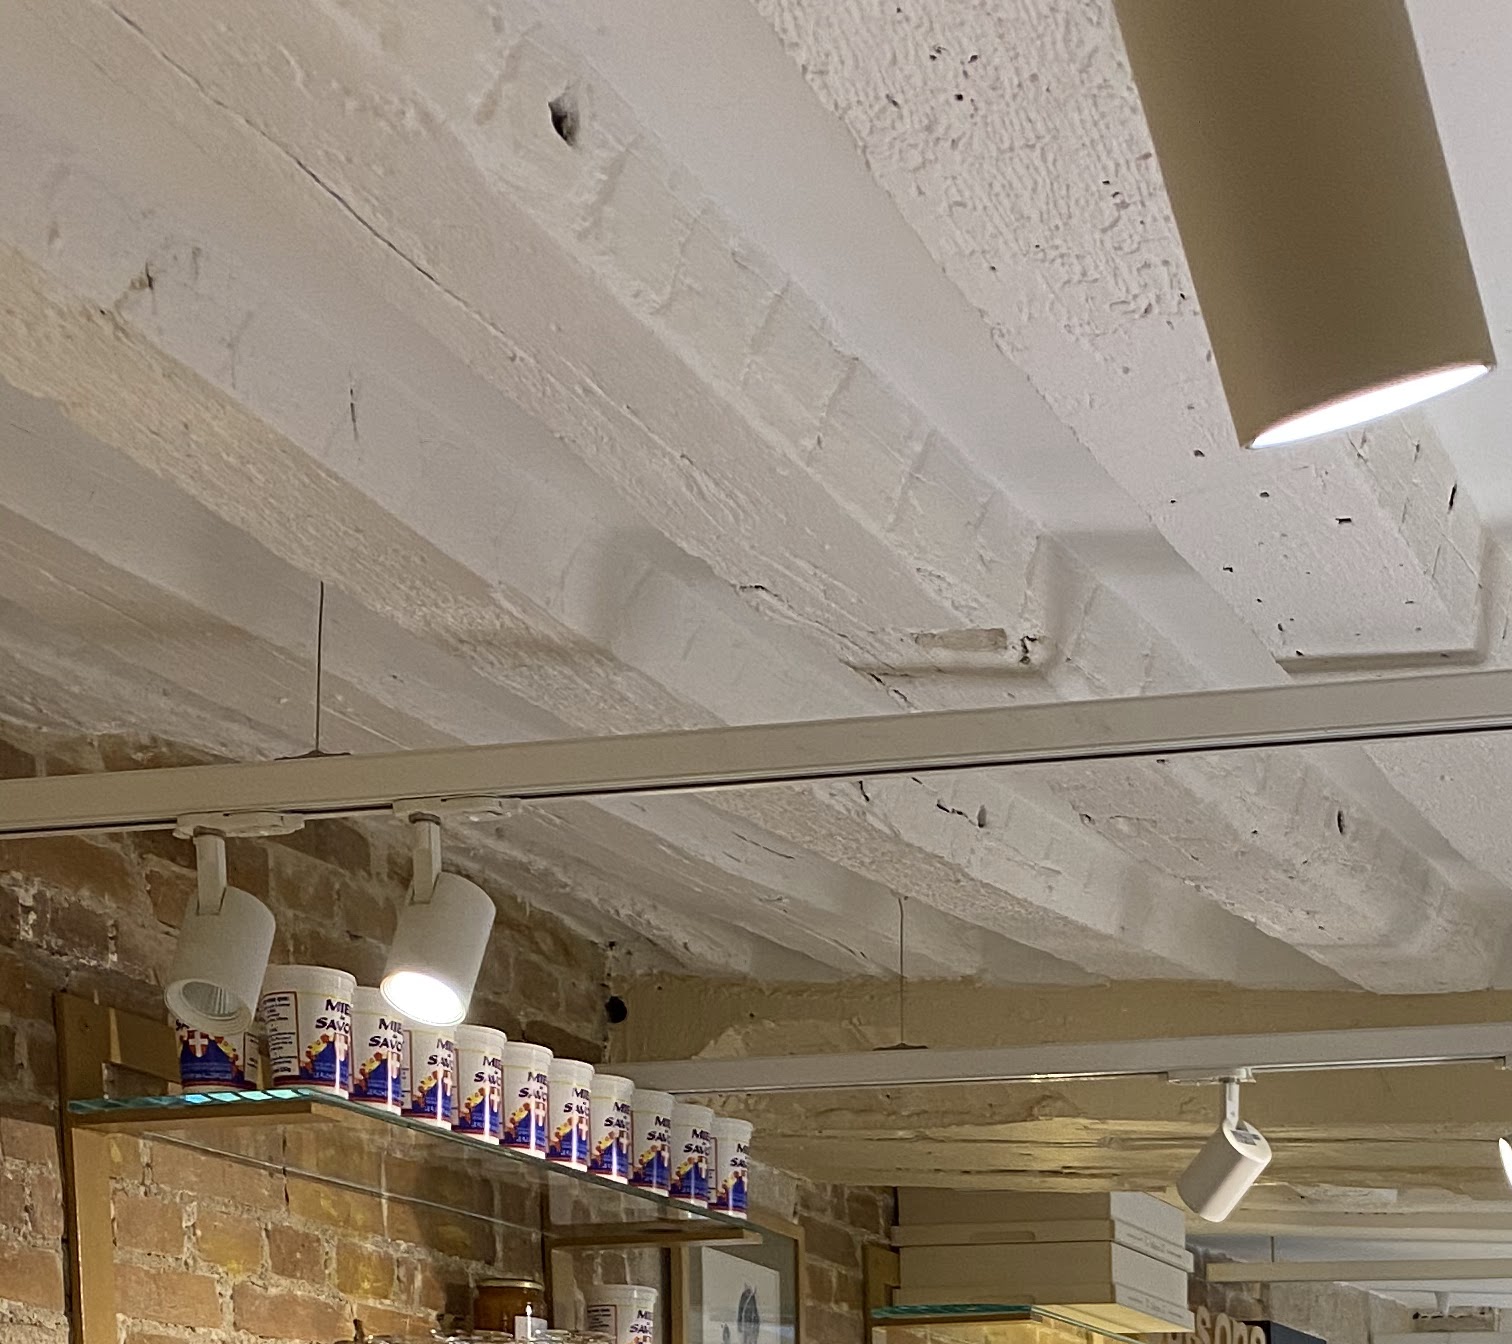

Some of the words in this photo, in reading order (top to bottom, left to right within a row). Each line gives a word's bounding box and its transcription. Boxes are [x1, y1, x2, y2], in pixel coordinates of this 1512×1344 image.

[325, 999, 351, 1014] MIE
[315, 1017, 351, 1033] SAVO
[378, 1018, 402, 1032] MIE
[368, 1035, 402, 1051] SAVO
